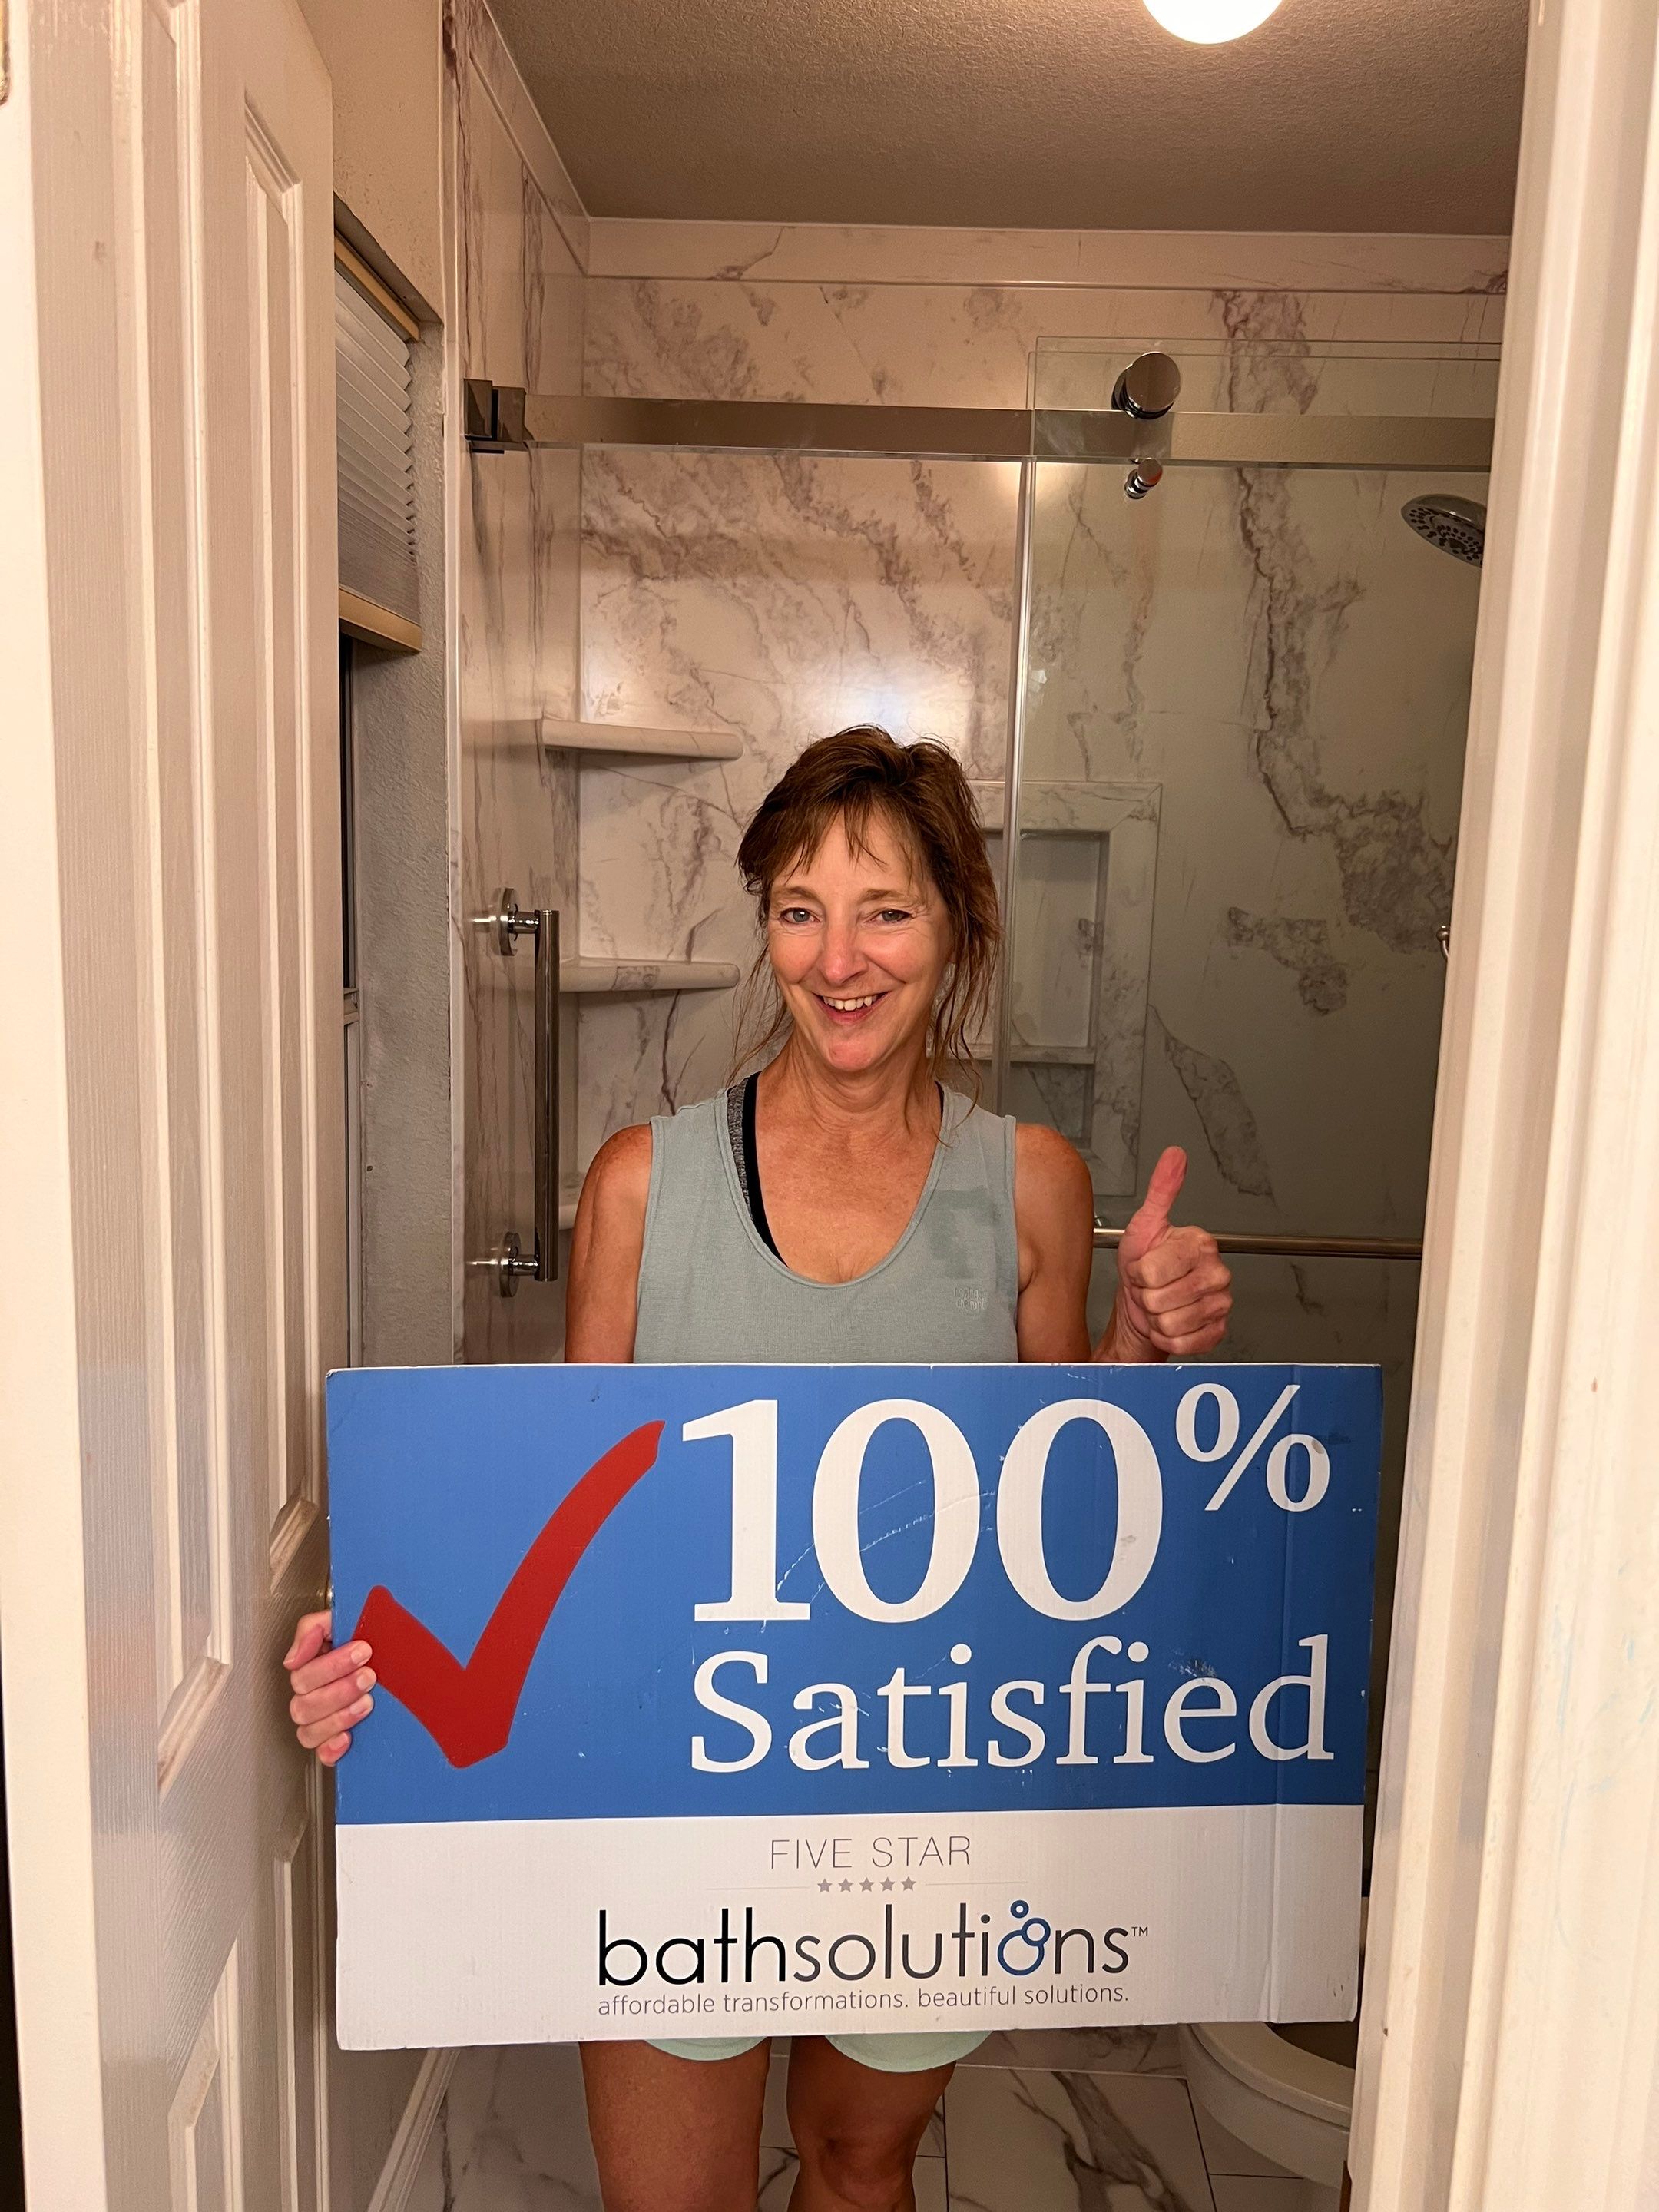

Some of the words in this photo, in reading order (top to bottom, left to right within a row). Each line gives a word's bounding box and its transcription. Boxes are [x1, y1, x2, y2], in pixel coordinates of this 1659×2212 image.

[682, 1382, 1331, 1626] 100%
[691, 1634, 1335, 1773] Satisfied
[770, 1838, 853, 1870] FIVE
[872, 1835, 972, 1868] STAR
[598, 1993, 715, 2016] affordable
[723, 1988, 909, 2012] transformations.
[918, 1985, 1016, 2008] beautiful
[1024, 1983, 1129, 2005] solutions.
